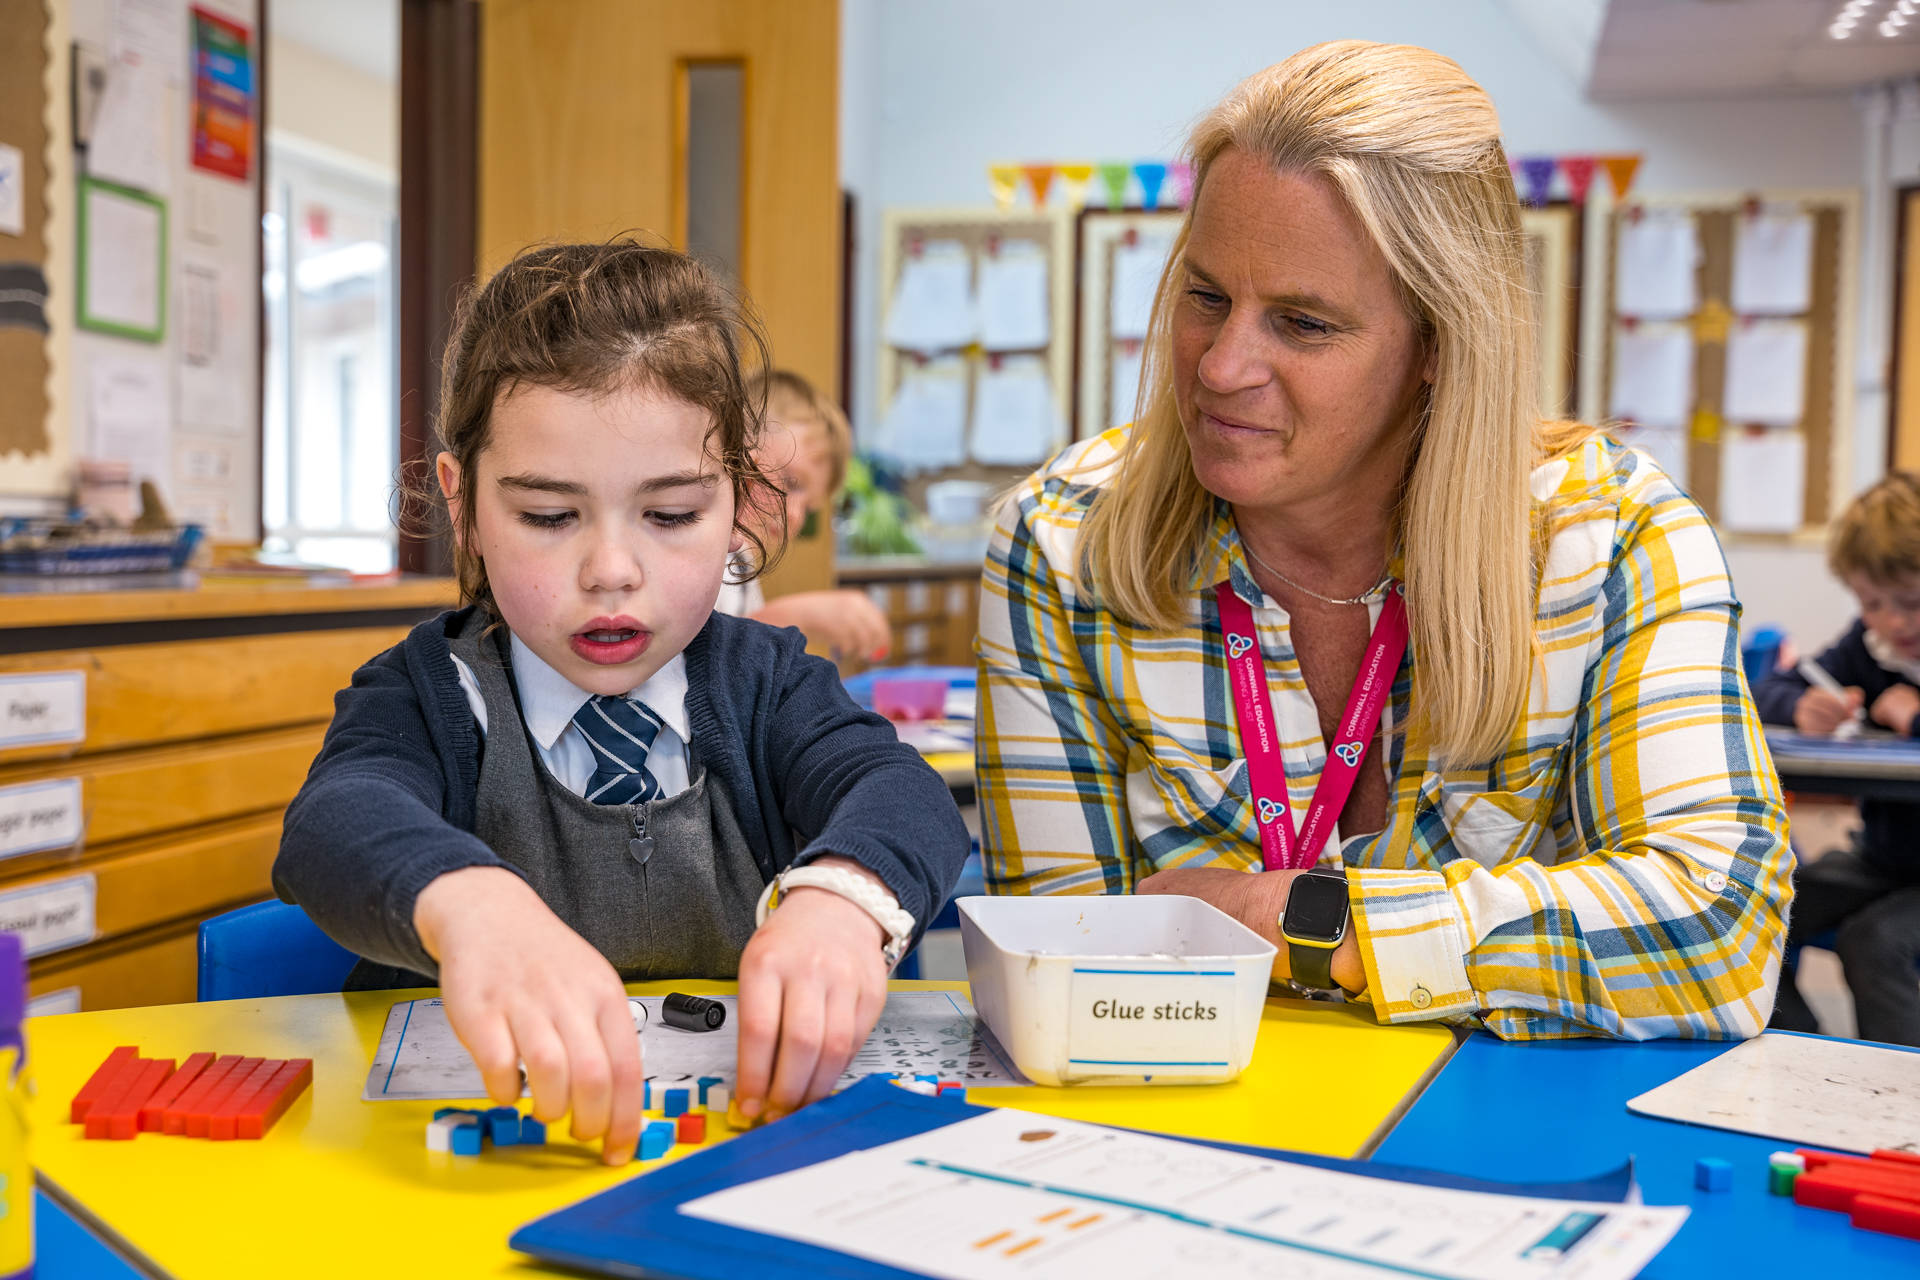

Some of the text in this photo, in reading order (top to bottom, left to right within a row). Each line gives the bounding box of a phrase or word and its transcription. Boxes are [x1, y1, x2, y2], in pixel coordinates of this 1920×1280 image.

[1235, 659, 1255, 722] LEARNING TRUST
[1245, 657, 1270, 753] CORNWALL EDUCATION
[1344, 643, 1386, 738] CORNWALL EDUCATION
[1355, 677, 1383, 740] LEARNING TRUST
[1301, 804, 1325, 851] EDUCATION
[1306, 837, 1319, 859] TRUST
[1092, 999, 1217, 1020] Glue sticks
